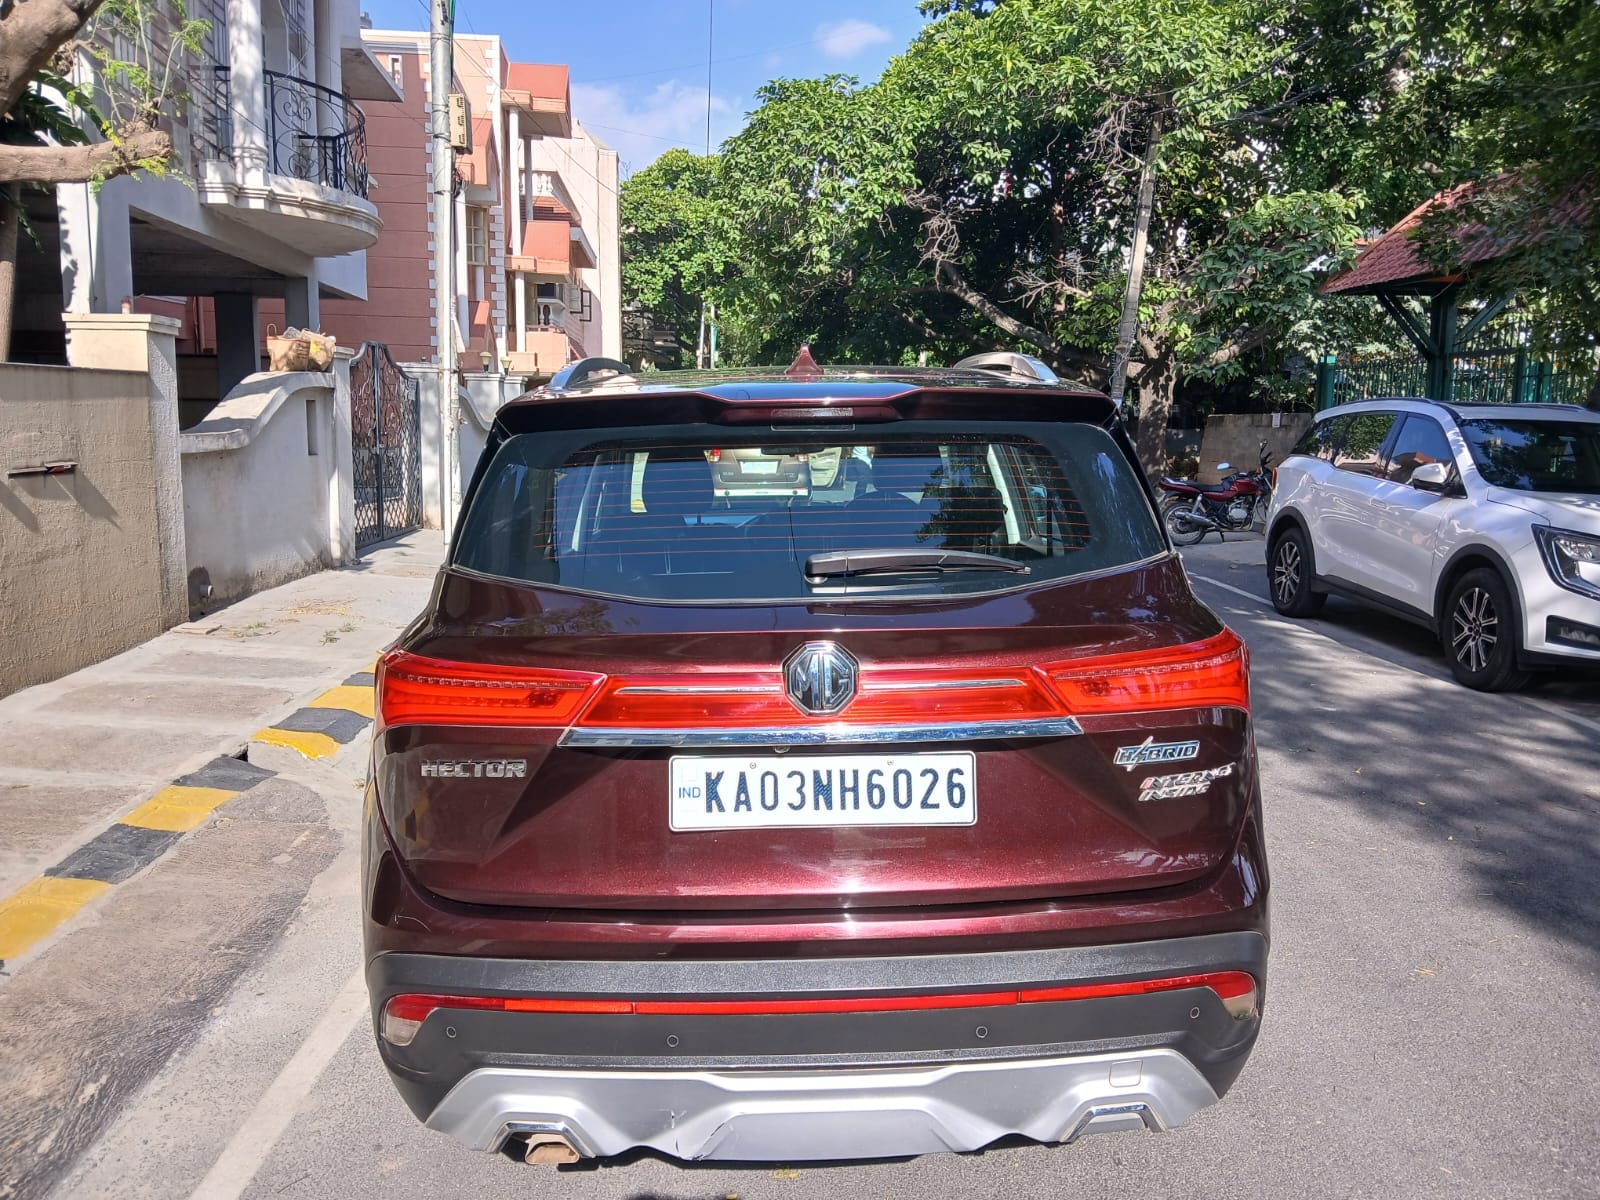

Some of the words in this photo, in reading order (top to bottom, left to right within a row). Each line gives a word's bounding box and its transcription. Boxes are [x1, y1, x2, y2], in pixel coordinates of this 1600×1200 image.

[790, 652, 850, 710] MG
[421, 759, 527, 778] HECTOR
[1115, 736, 1200, 770] HYBRID
[678, 786, 701, 799] IND
[705, 767, 966, 813] KA03NH6026
